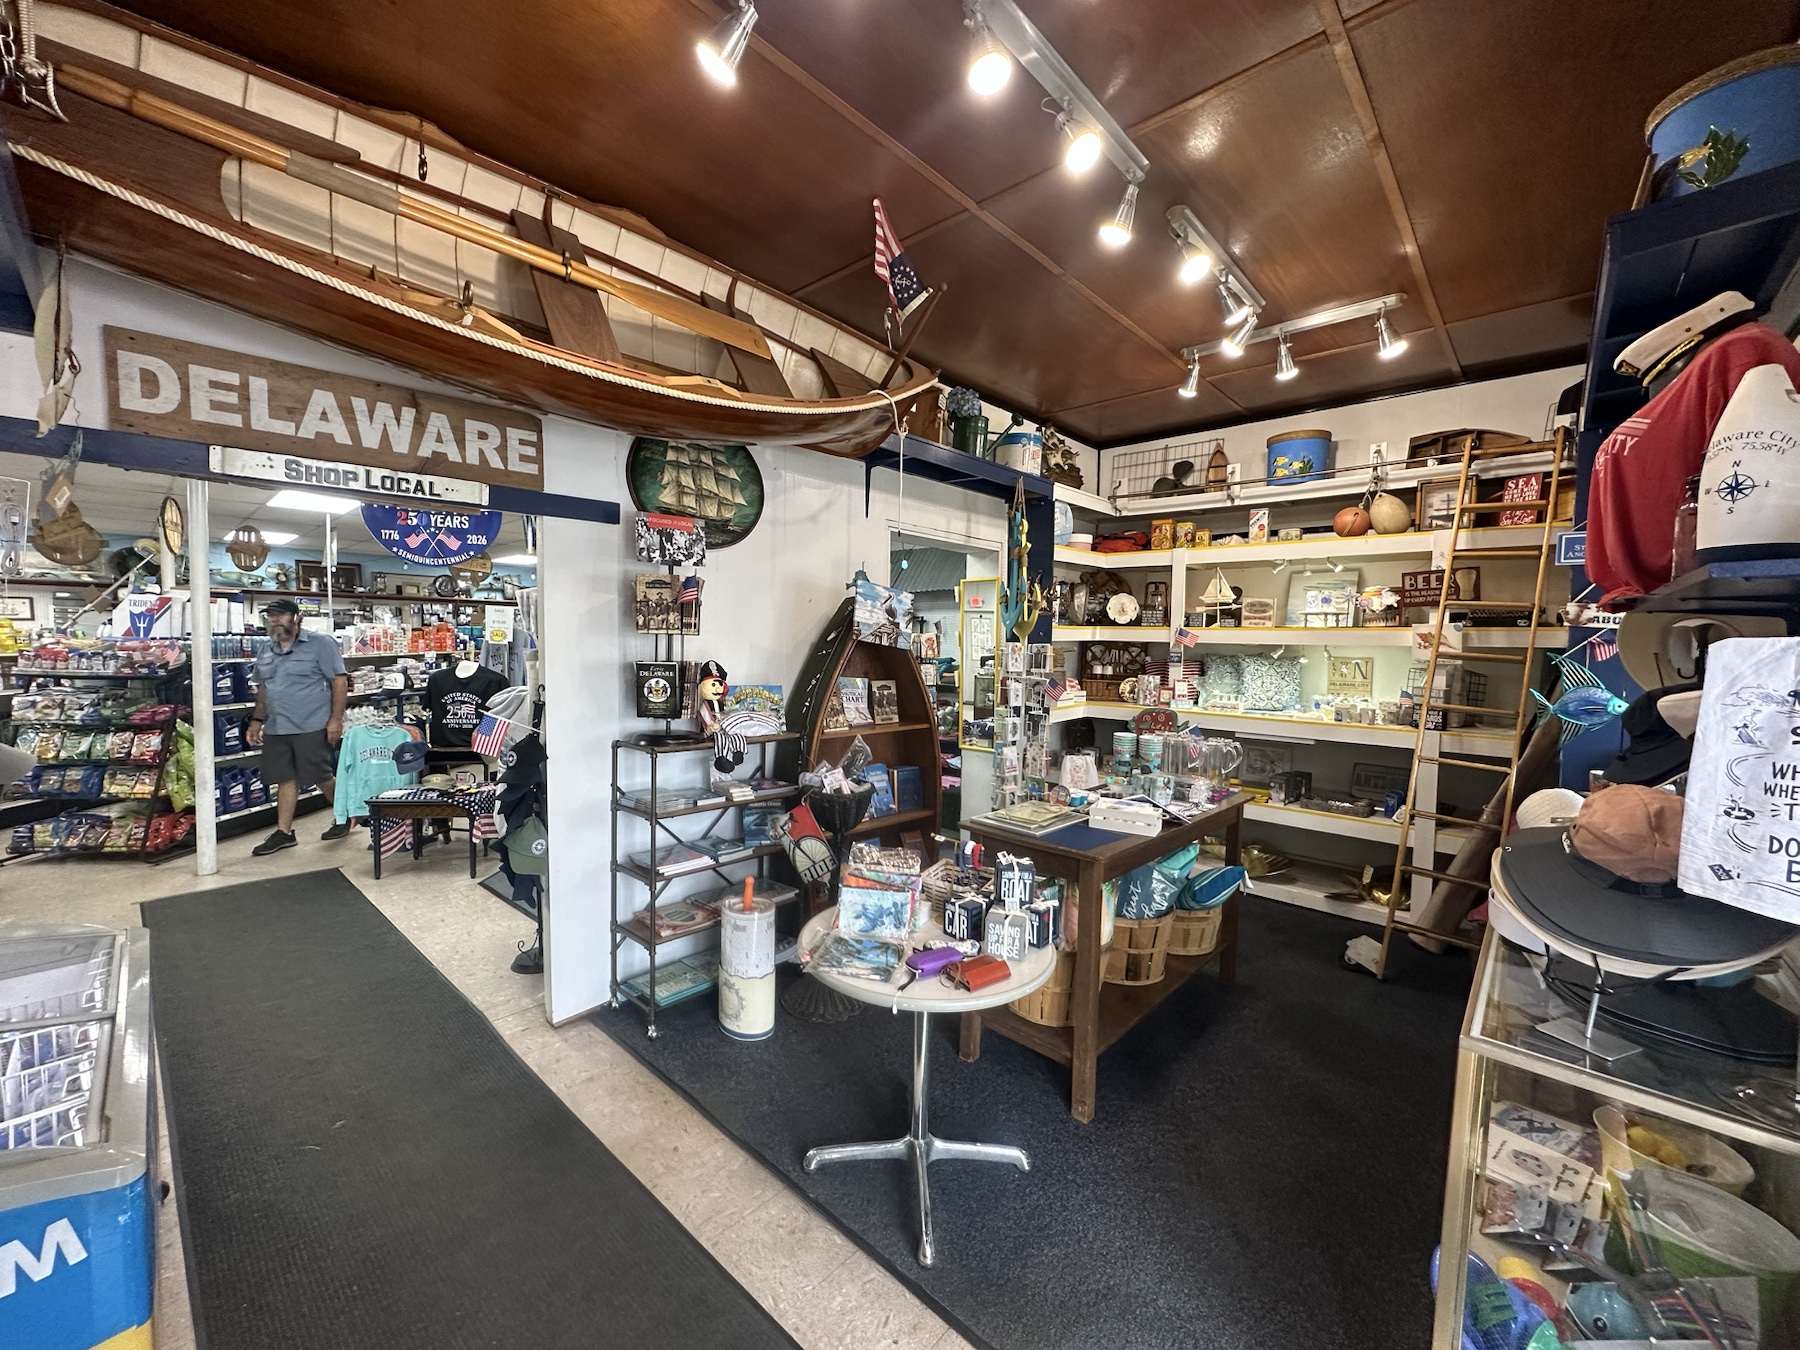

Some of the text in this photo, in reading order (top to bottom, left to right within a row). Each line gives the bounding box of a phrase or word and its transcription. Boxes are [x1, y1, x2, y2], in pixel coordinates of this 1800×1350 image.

[117, 349, 539, 475] DELAWARE
[1607, 433, 1640, 456] ITY
[1708, 430, 1800, 453] laware City
[1731, 459, 1742, 468] N
[284, 458, 442, 498] SHOP LOCAL
[1508, 476, 1537, 490] SEA
[397, 510, 469, 529] 250 YEARS
[1726, 506, 1735, 515] S
[381, 529, 488, 546] 1776 2026
[397, 548, 471, 566] SEMIQUINCENTENNIAL
[1404, 573, 1456, 590] BEER
[1352, 661, 1369, 680] N
[441, 692, 482, 704] UNITED STATES
[453, 696, 476, 705] AMERICA
[1763, 781, 1800, 801] WHE
[1768, 834, 1800, 858] DO
[801, 856, 837, 884] RIDE
[1001, 878, 1033, 902] BOAT
[945, 909, 968, 940] CAR
